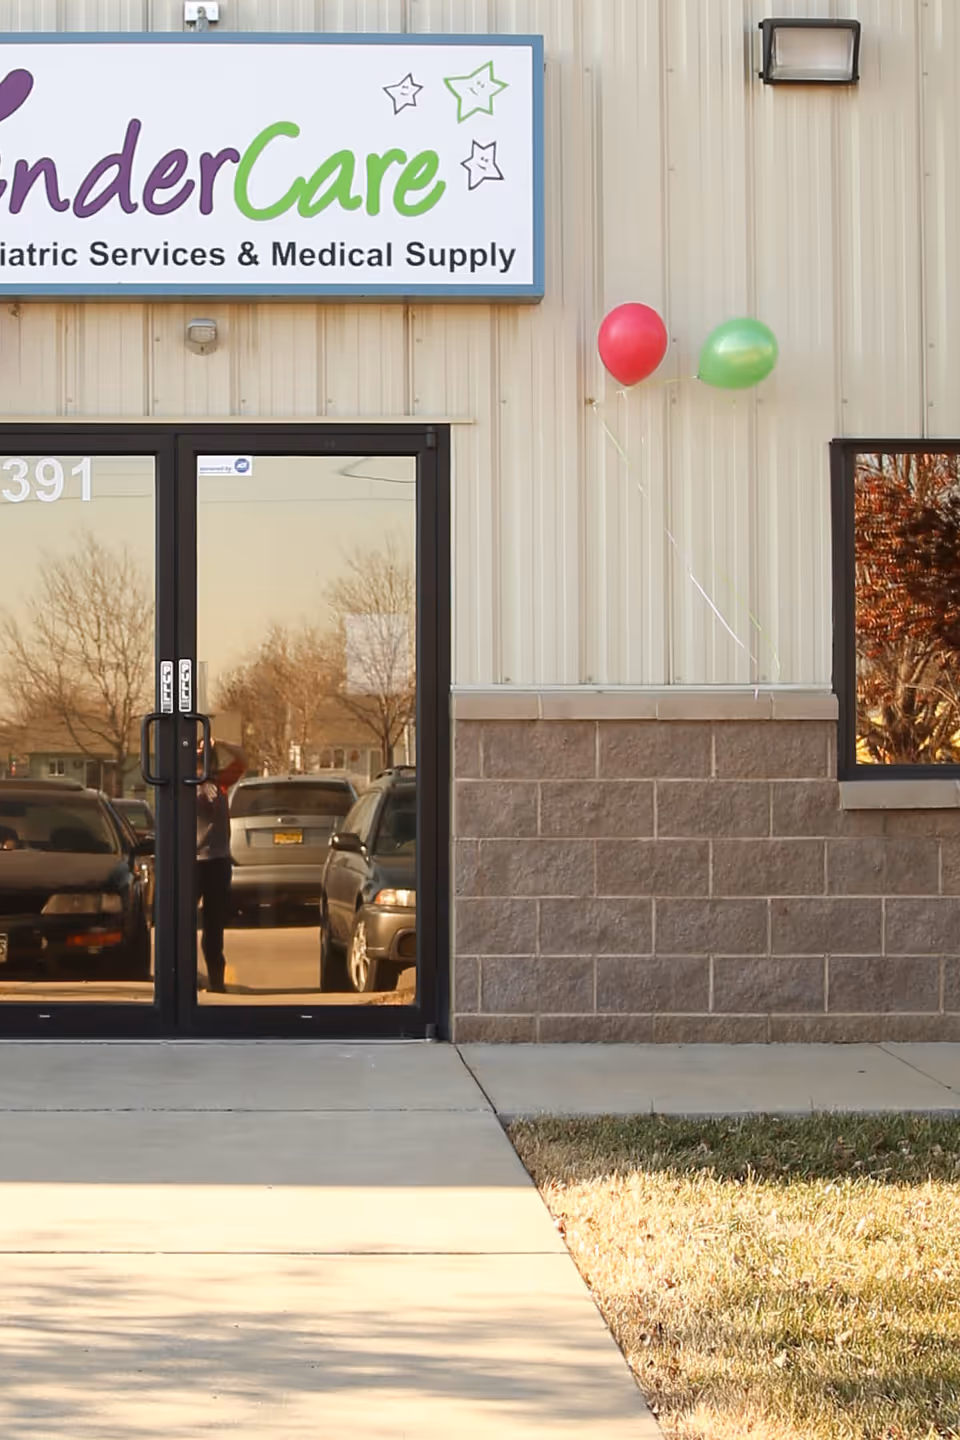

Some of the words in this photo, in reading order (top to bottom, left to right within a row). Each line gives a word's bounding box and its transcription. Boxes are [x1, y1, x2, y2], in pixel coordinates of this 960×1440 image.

[89, 241, 226, 267] Services
[237, 241, 260, 267] &
[272, 241, 392, 267] Medical
[406, 241, 516, 274] Supply
[1, 456, 92, 502] 391
[163, 665, 171, 701] PULL
[180, 663, 190, 699] PULL
